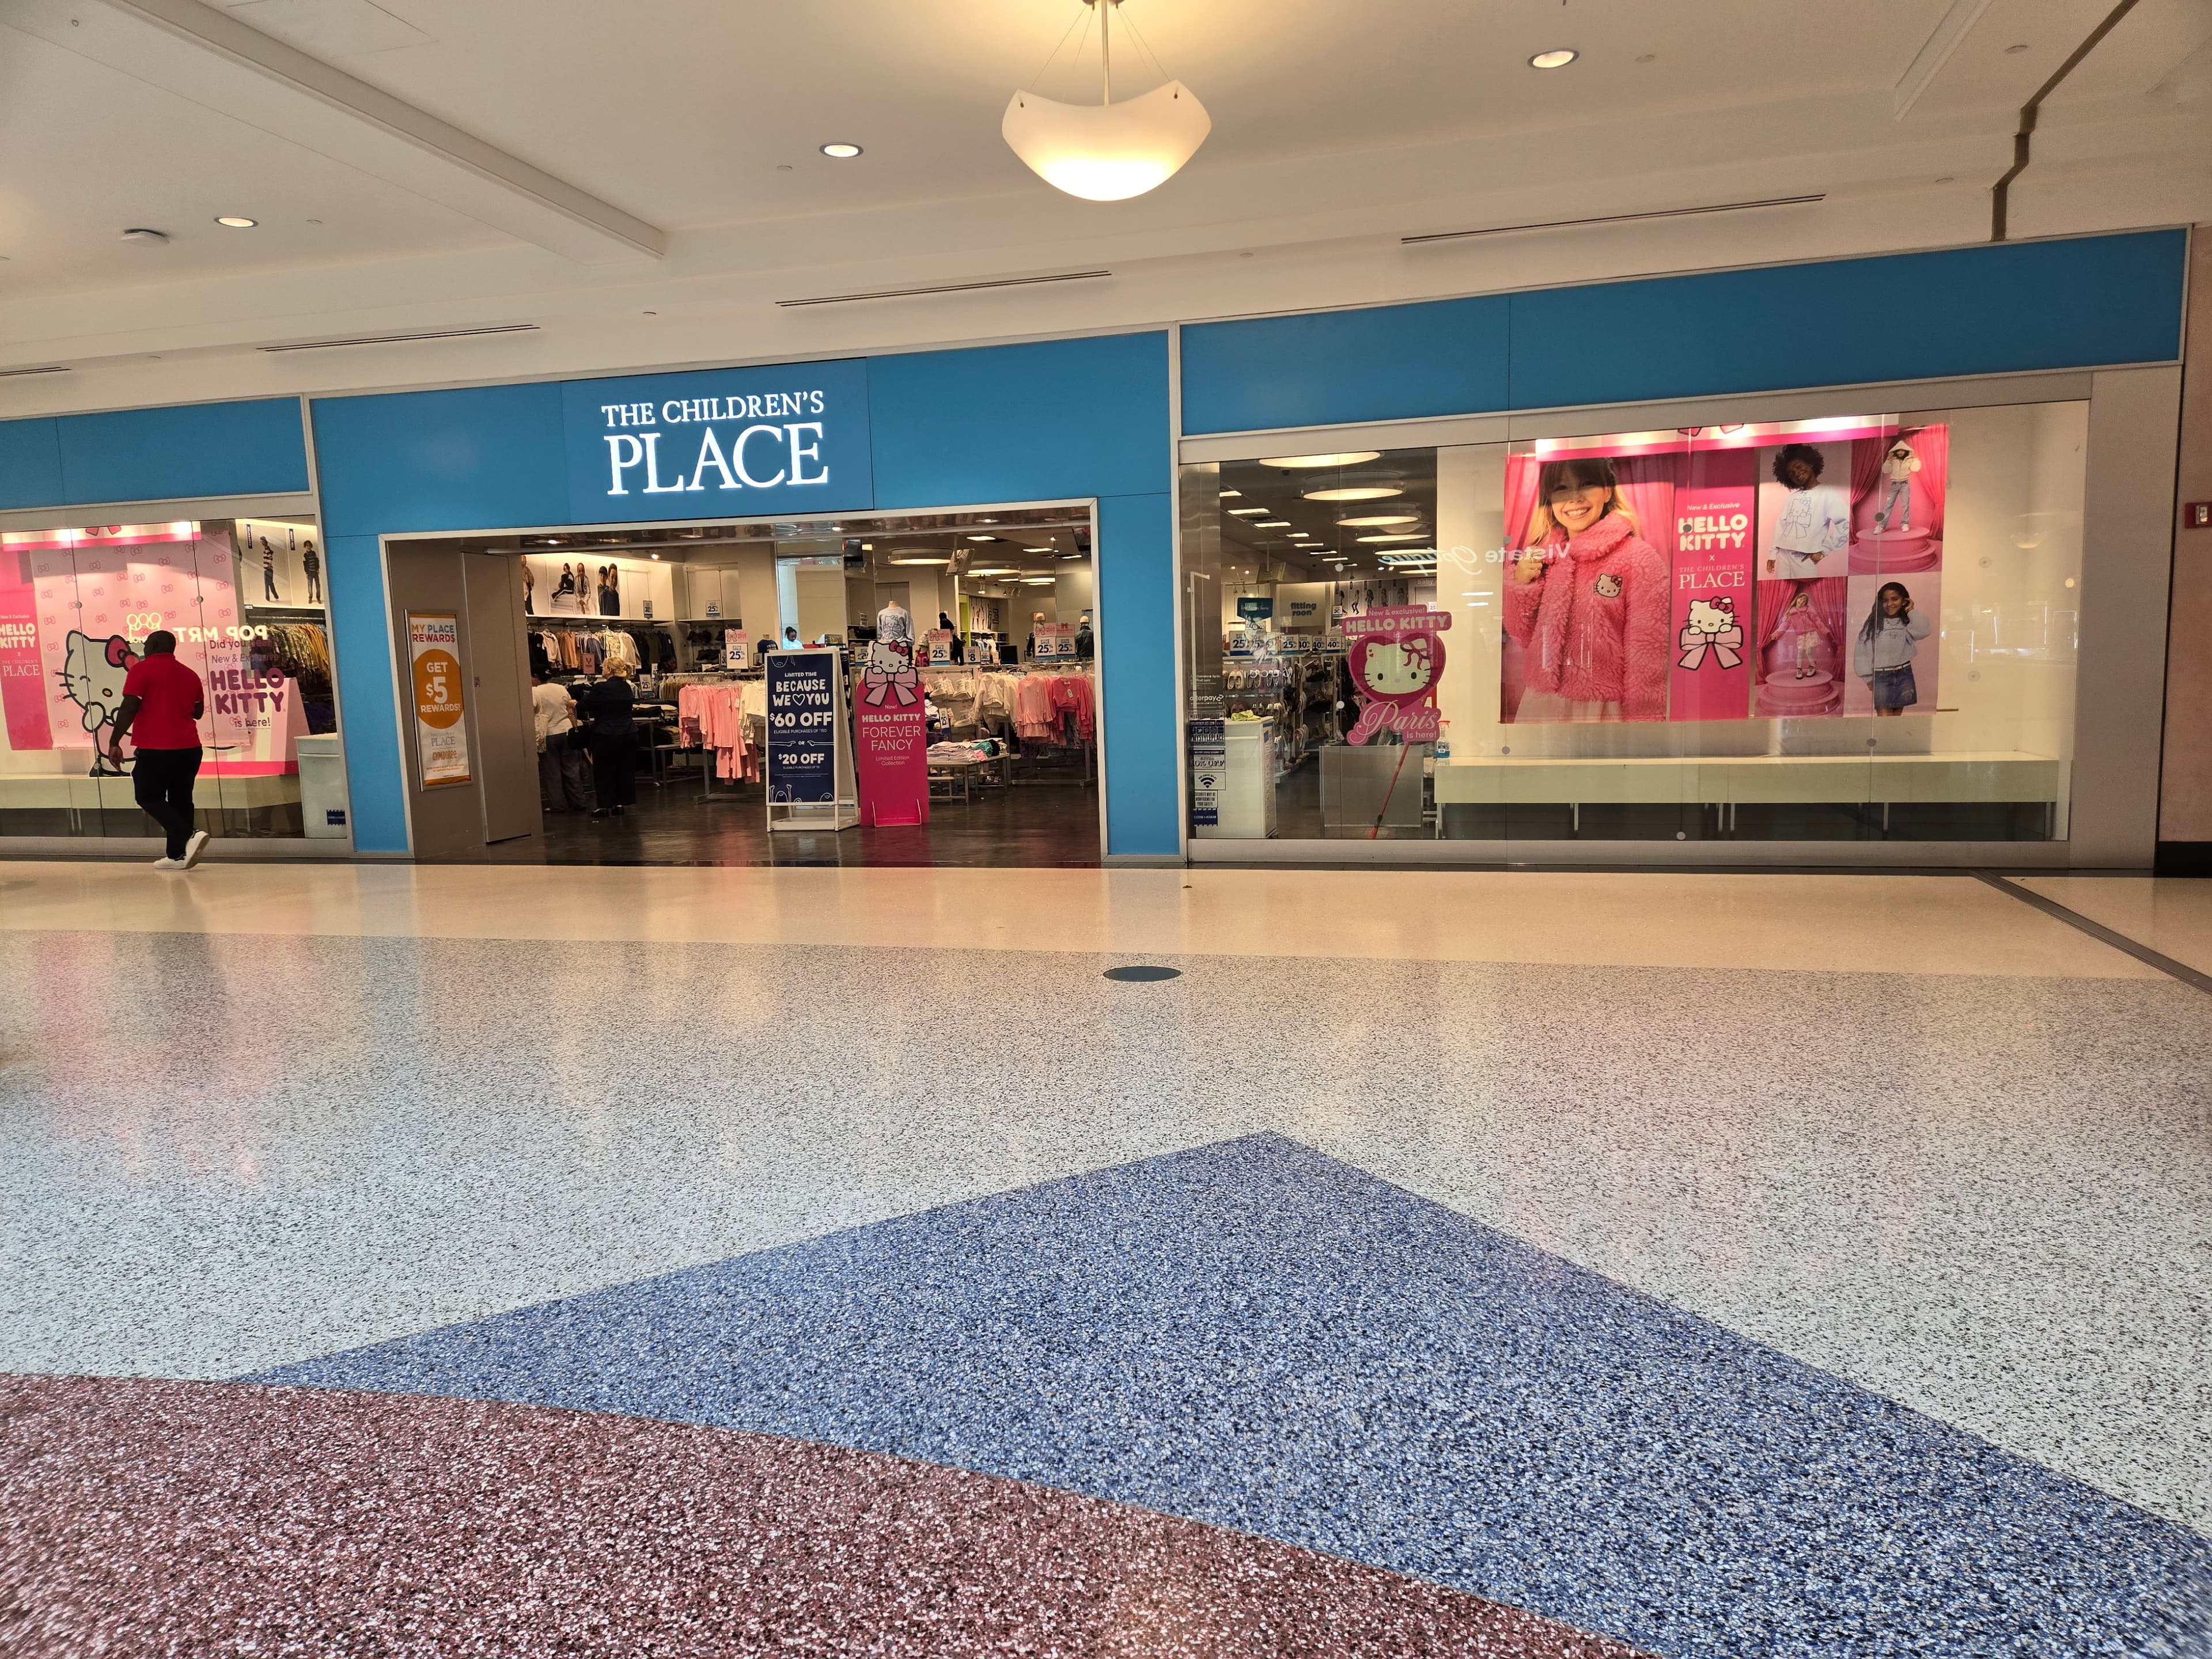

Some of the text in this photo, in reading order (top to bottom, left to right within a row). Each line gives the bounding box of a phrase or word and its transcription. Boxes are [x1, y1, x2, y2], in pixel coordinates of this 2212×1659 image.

[601, 390, 824, 427] THE CHILDREN'S
[603, 422, 828, 496] PLACE
[1678, 514, 1748, 534] HELLO
[1679, 532, 1746, 551] KITTY
[1697, 564, 1744, 572] CHILDREN'S
[1679, 571, 1745, 589] PLACE
[1291, 602, 1317, 610] fitting
[0, 623, 35, 636] HELLO
[411, 624, 454, 633] MY PLACE
[1346, 615, 1448, 632] HELLO KITTY
[0, 636, 35, 649] KITTY
[210, 640, 226, 649] Did
[229, 641, 246, 650] you
[211, 654, 279, 663] New & Exclusive
[3, 664, 40, 677] PLACE
[426, 662, 448, 673] GET
[210, 668, 284, 691] HELLO
[776, 679, 826, 692] BECAUSE
[426, 676, 448, 704] $5
[215, 691, 284, 715] KITTY
[772, 692, 830, 706] WE YOU
[421, 704, 460, 713] REWARDS!
[234, 717, 271, 728] is here!
[770, 711, 832, 727] $60 OFF
[862, 713, 921, 723] HELLO KITTY
[1350, 700, 1438, 744] Paris
[862, 725, 921, 738] FOREVER
[1415, 730, 1437, 738] here!
[431, 737, 456, 747] PLACE
[871, 738, 912, 751] FANCY
[778, 753, 825, 764] $20 OFF
